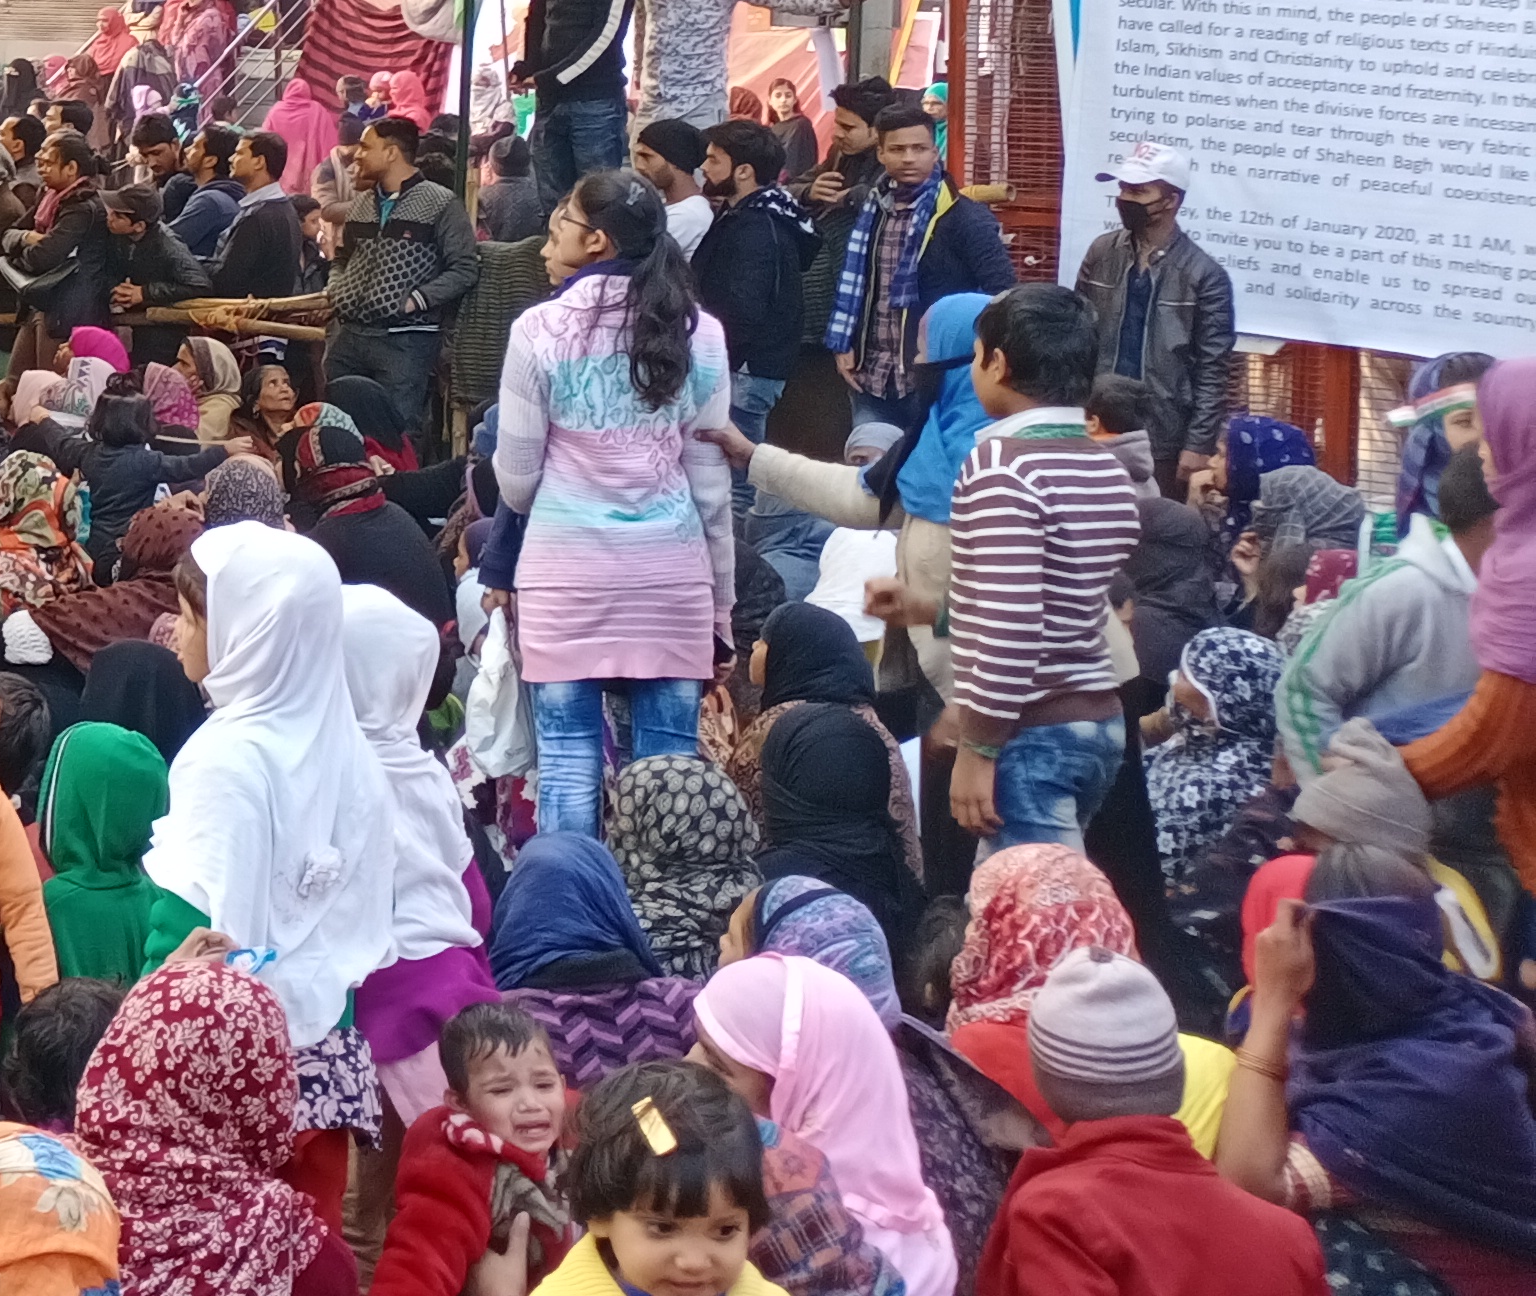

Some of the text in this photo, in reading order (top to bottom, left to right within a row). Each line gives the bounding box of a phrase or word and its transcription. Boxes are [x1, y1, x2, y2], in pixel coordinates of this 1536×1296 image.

[1118, 15, 1153, 33] have
[1159, 19, 1202, 36] called
[1208, 21, 1231, 38] for
[1235, 27, 1244, 39] a
[1250, 26, 1309, 47] reading
[1315, 29, 1330, 45] of
[1336, 31, 1403, 51] religious
[1410, 34, 1449, 53] texts
[1455, 38, 1472, 54] of
[1223, 0, 1251, 17] this
[1257, 2, 1270, 18] in
[1328, 6, 1354, 23] the
[1360, 10, 1416, 29] people
[1423, 12, 1438, 28] of
[1444, 13, 1516, 32] Shaheen
[1166, 41, 1223, 60] Sikhism
[1230, 47, 1258, 63] and
[1264, 48, 1353, 74] Christianity
[1359, 55, 1375, 72] to
[1383, 59, 1438, 78] uphold
[1445, 64, 1474, 80] and
[1202, 135, 1226, 153] the
[1233, 141, 1286, 161] people
[1293, 145, 1309, 161] of
[1316, 146, 1384, 168] Shaheen
[1394, 154, 1432, 175] Bagh
[1441, 161, 1491, 178] would
[1501, 164, 1529, 182] like
[1207, 204, 1232, 222] the
[1240, 207, 1273, 226] 12th
[1281, 213, 1297, 229] of
[1304, 215, 1368, 241] January
[1428, 230, 1444, 246] at
[1453, 232, 1471, 249] 11
